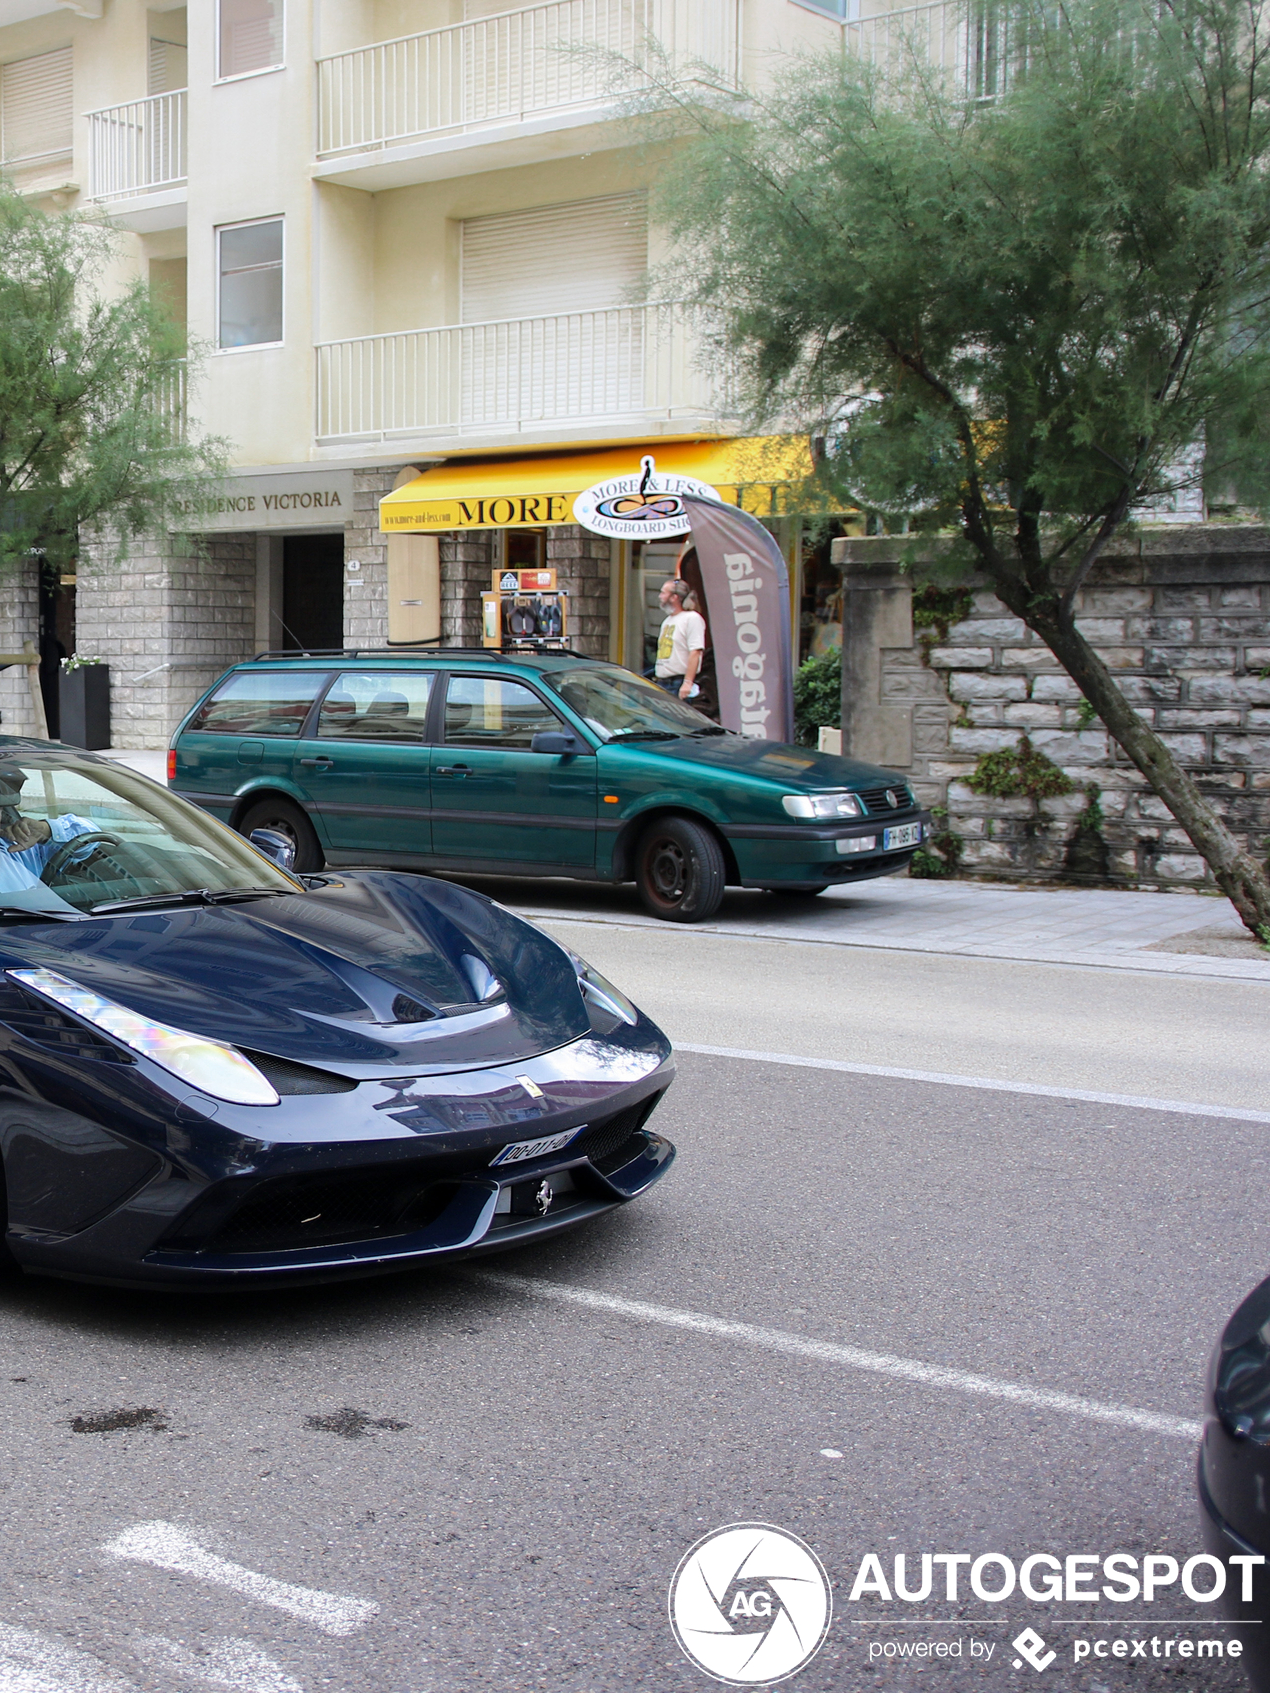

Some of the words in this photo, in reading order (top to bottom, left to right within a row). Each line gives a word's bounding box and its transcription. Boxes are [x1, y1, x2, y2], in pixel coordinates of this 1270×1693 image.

[262, 491, 342, 510] VICTORIA
[592, 478, 639, 502] MORE
[648, 478, 660, 491] &
[665, 478, 707, 497] LESS
[456, 495, 568, 526] MORE
[591, 515, 670, 534] LONGBOARD
[670, 519, 691, 530] SHO
